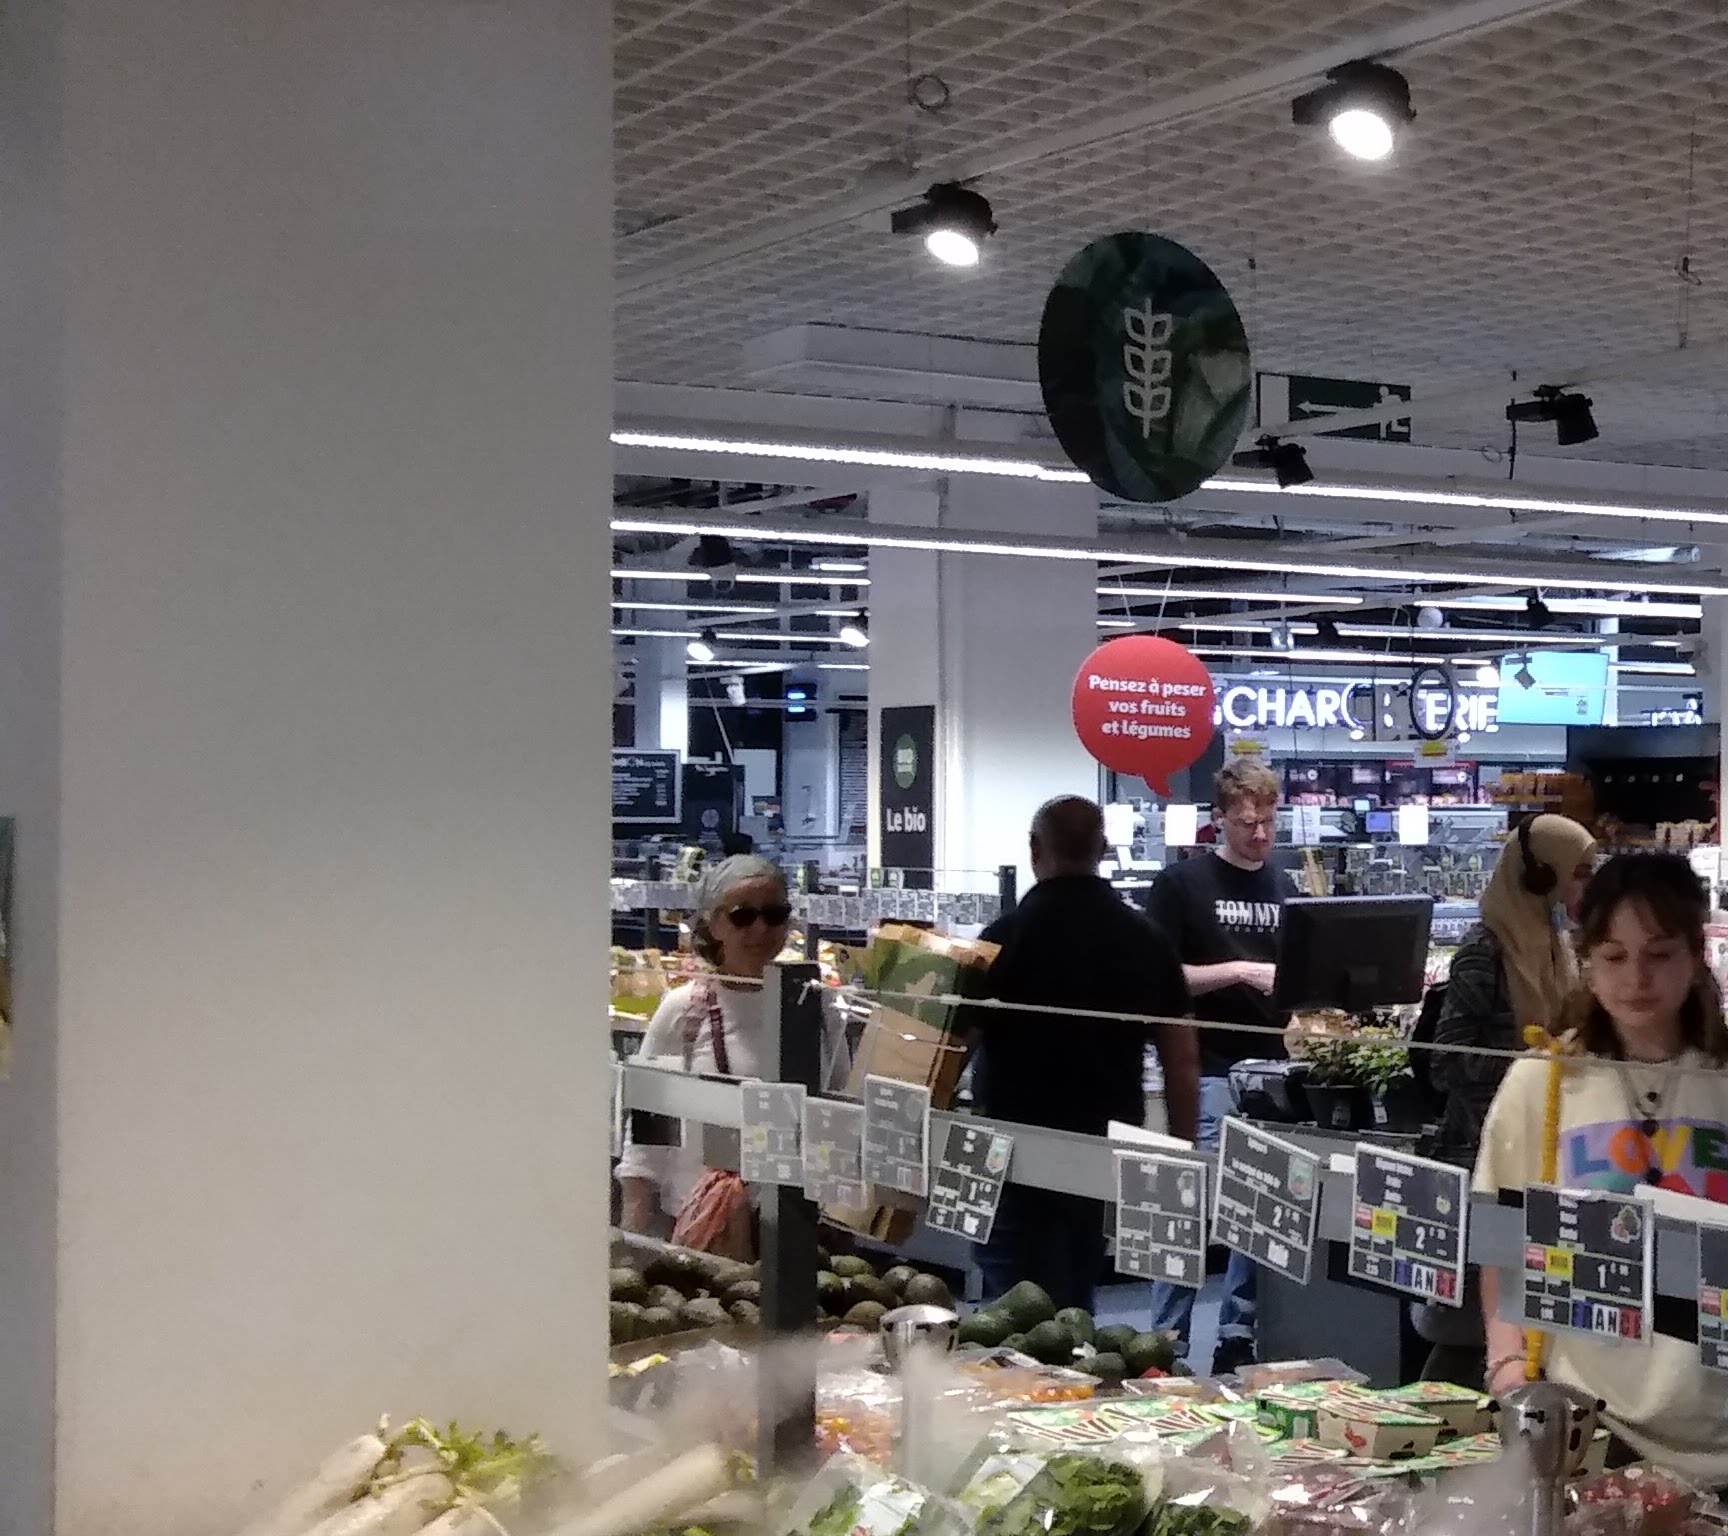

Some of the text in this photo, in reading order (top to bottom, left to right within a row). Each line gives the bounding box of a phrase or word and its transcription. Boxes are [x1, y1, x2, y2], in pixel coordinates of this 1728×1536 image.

[1088, 675, 1207, 698] Pensez à peser
[1109, 700, 1186, 717] vos fruits
[1102, 719, 1191, 740] et légumes
[886, 805, 926, 833] Le bio
[1215, 900, 1281, 928] TOMMY
